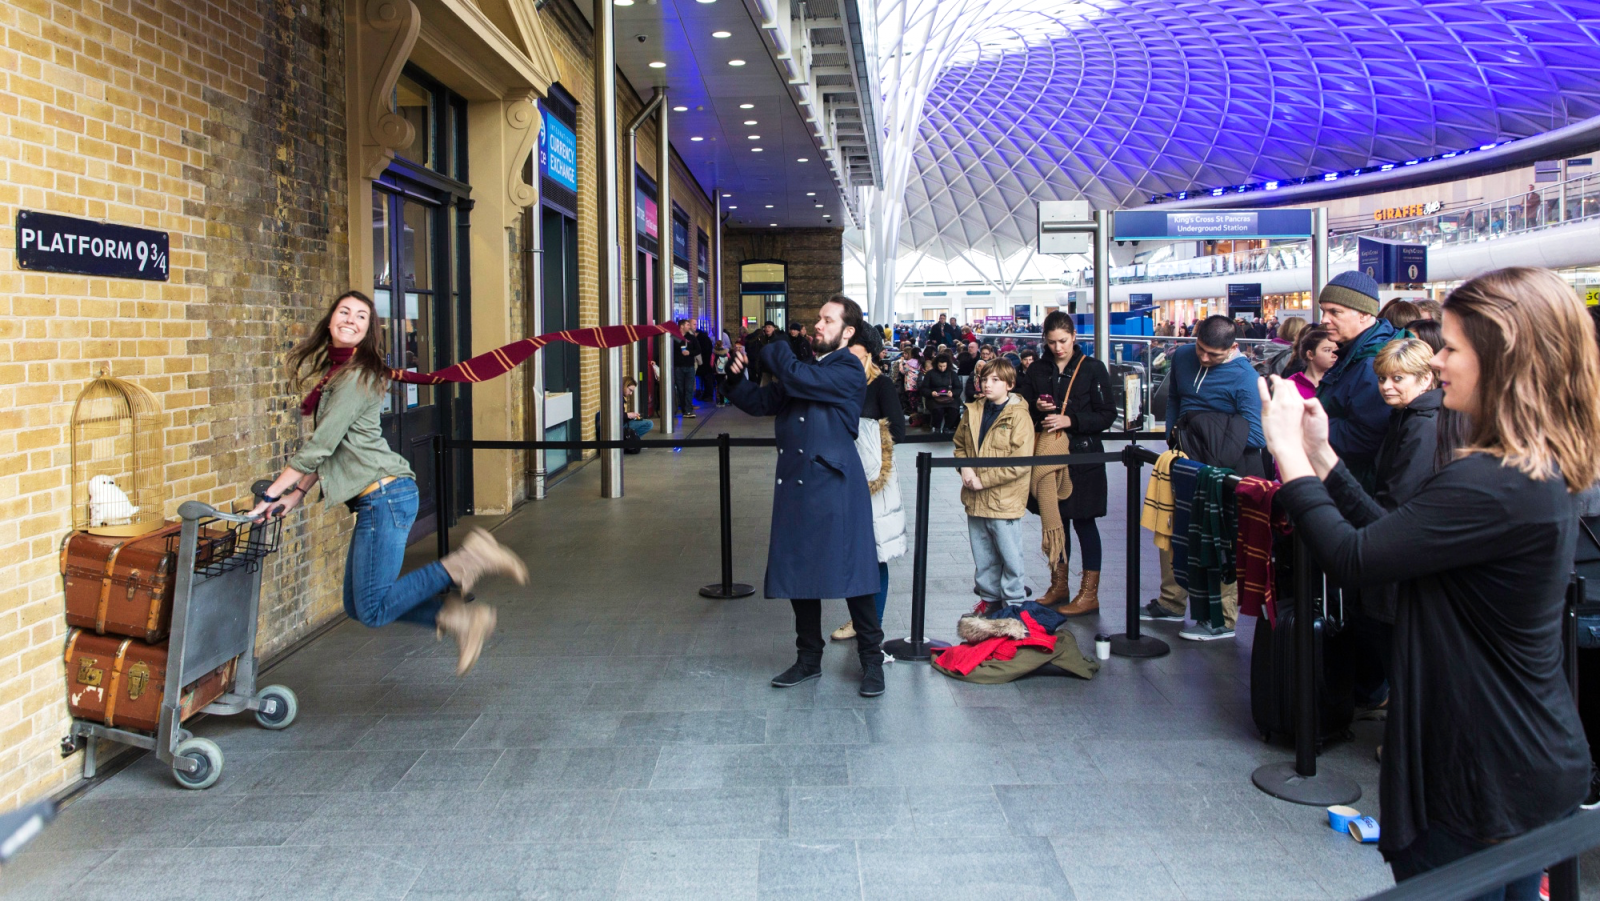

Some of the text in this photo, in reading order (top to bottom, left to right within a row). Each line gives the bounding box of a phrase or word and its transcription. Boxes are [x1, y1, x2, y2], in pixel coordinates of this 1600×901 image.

[549, 133, 575, 165] CURRENCY
[550, 153, 575, 183] EXCHANGE
[1174, 216, 1194, 224] King's
[1374, 204, 1423, 220] GIRAFFE
[1177, 225, 1222, 233] Underground
[21, 227, 133, 260] PLATFORM
